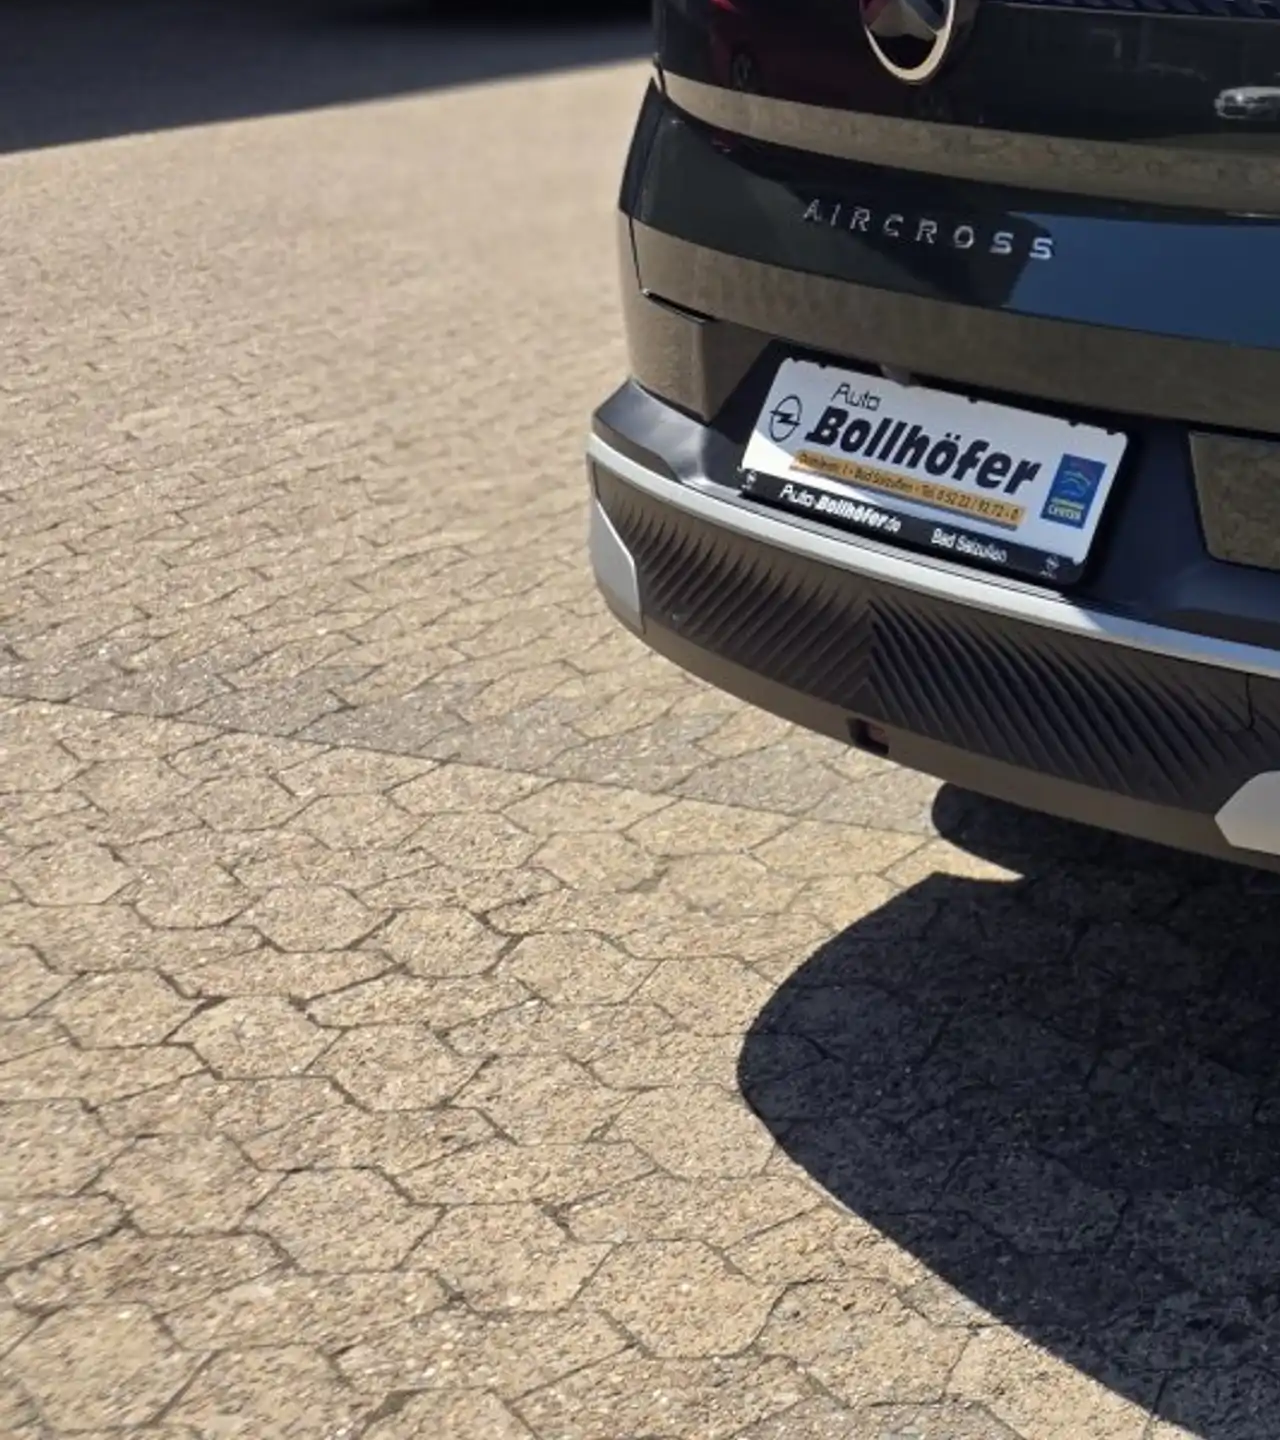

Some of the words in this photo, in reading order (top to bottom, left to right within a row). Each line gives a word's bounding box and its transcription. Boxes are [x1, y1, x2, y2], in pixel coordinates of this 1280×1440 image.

[803, 198, 1054, 260] AIRCROSS
[831, 382, 883, 412] Auto
[804, 405, 1042, 495] Bollhöfer
